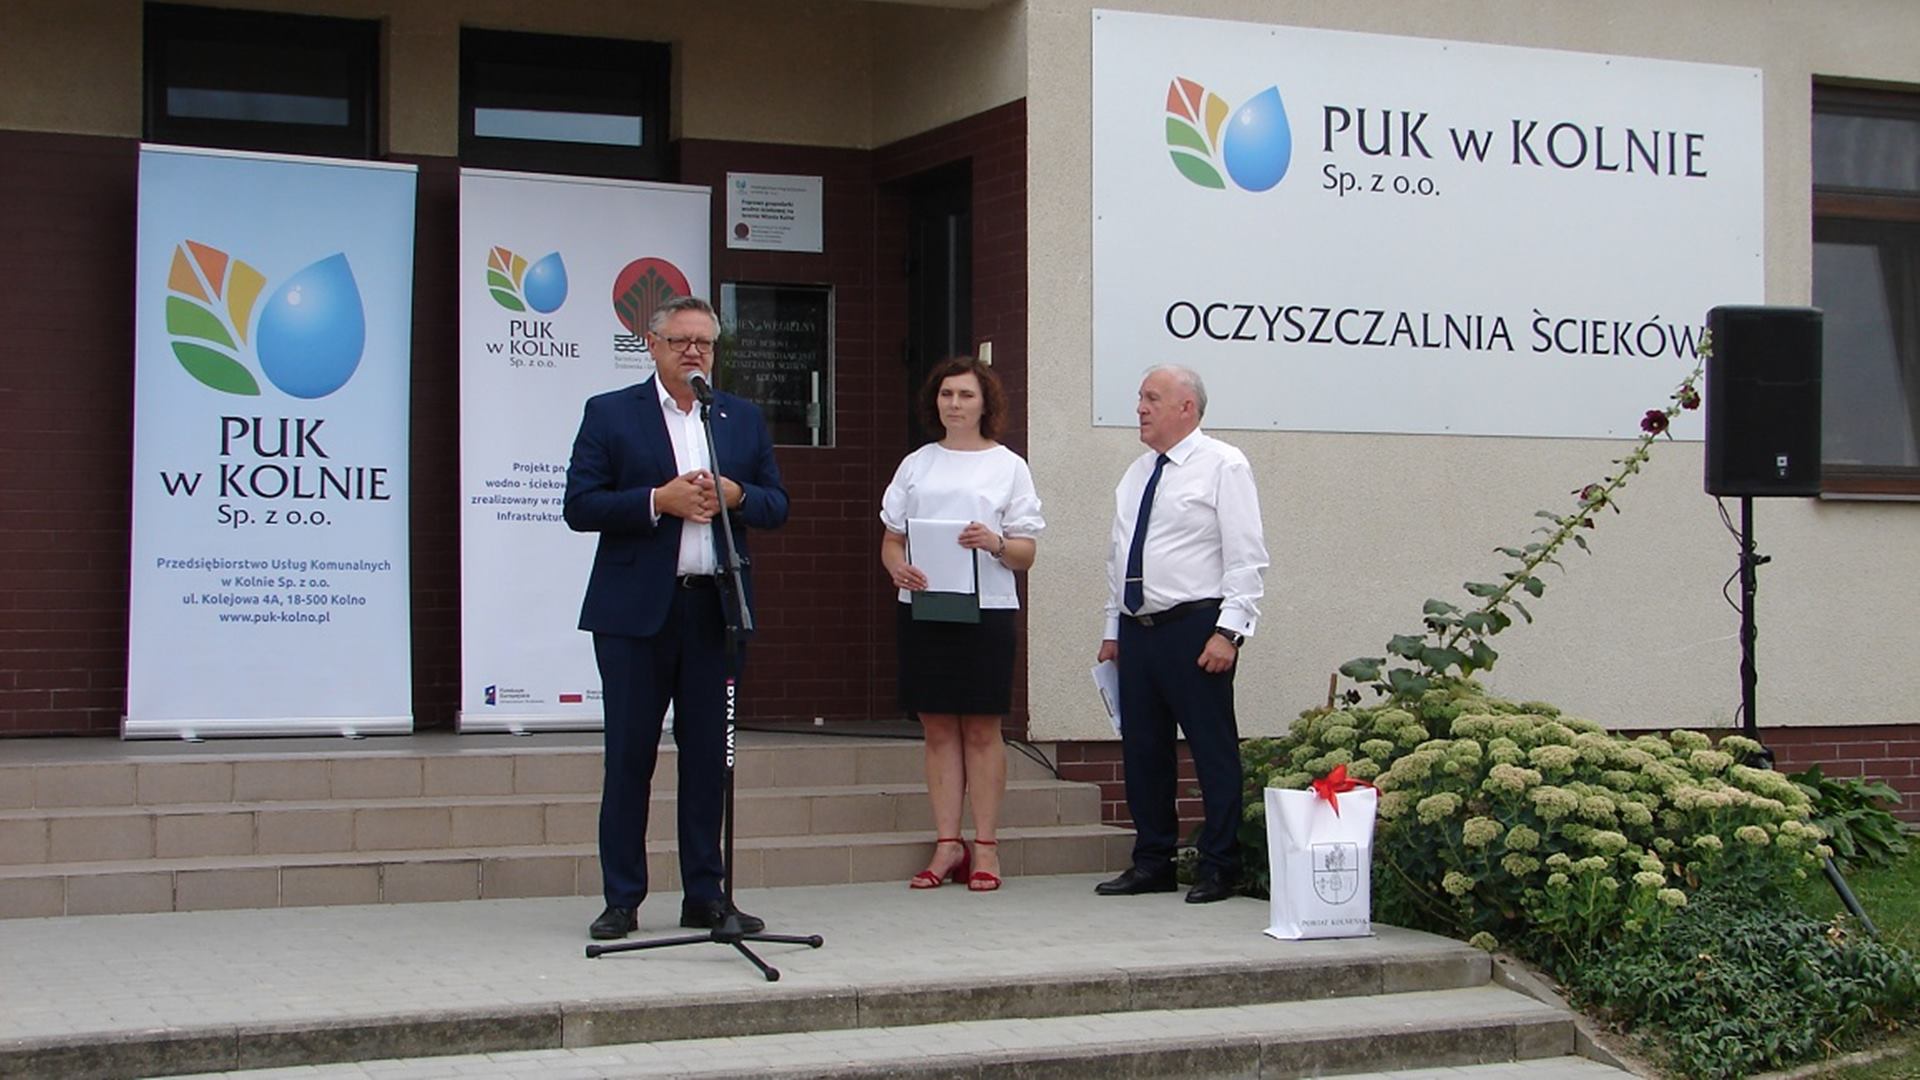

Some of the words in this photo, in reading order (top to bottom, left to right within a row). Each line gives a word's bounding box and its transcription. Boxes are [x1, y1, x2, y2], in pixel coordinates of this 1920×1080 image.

[1322, 105, 1434, 159] PUK
[1449, 127, 1494, 163] w
[1511, 119, 1708, 178] KOLNIE
[1322, 164, 1363, 197] Sp.
[1370, 173, 1384, 193] z
[1393, 175, 1440, 196] o.o.
[510, 320, 554, 339] PUK
[1165, 301, 1515, 352] OCZYSZCZALNIA
[486, 343, 504, 354] w
[510, 340, 580, 358] KOLNIE
[509, 357, 526, 368] Sp.
[529, 359, 535, 367] z
[219, 416, 330, 459] PUK
[513, 463, 550, 473] Projekt
[160, 472, 202, 496] w
[219, 464, 391, 500] KOLNIE
[486, 480, 520, 488] wodno
[471, 495, 538, 507] zrealizowany
[217, 504, 256, 529] Sp.
[265, 510, 278, 525] z
[286, 510, 332, 525] o.o.
[157, 557, 268, 571] Przedsiębiorstwo
[271, 560, 308, 572] Usług
[310, 559, 391, 571] Komunalnych
[221, 579, 231, 587] w
[235, 577, 275, 587] Kolnie
[278, 577, 297, 589] Sp.
[300, 579, 306, 587] z
[310, 579, 330, 588] o.o.
[183, 594, 199, 605] ul.
[202, 594, 260, 607] Kolejowa
[262, 594, 284, 607] 4A,
[287, 595, 328, 605] 18-500
[331, 595, 367, 606] Kolno
[219, 612, 331, 624] www.puk-kolno.pl
